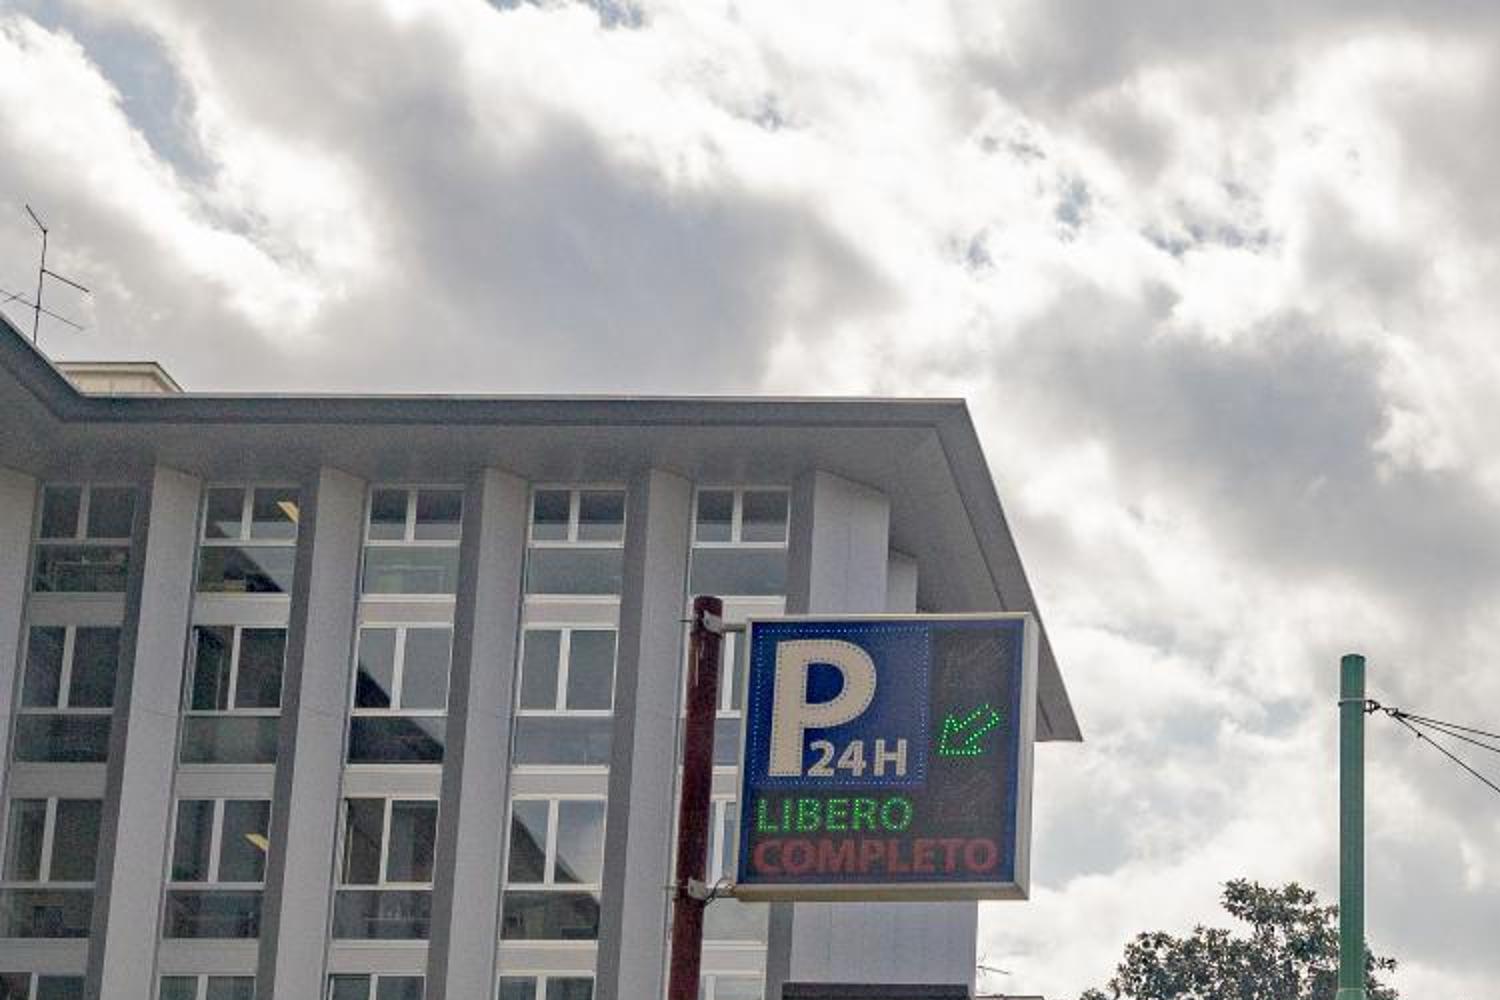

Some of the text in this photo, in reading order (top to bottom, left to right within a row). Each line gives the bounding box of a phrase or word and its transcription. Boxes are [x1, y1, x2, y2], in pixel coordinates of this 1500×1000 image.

[769, 639, 908, 777] P 24H
[756, 797, 914, 833] LIBERO
[752, 838, 1000, 875] COMPLETO
